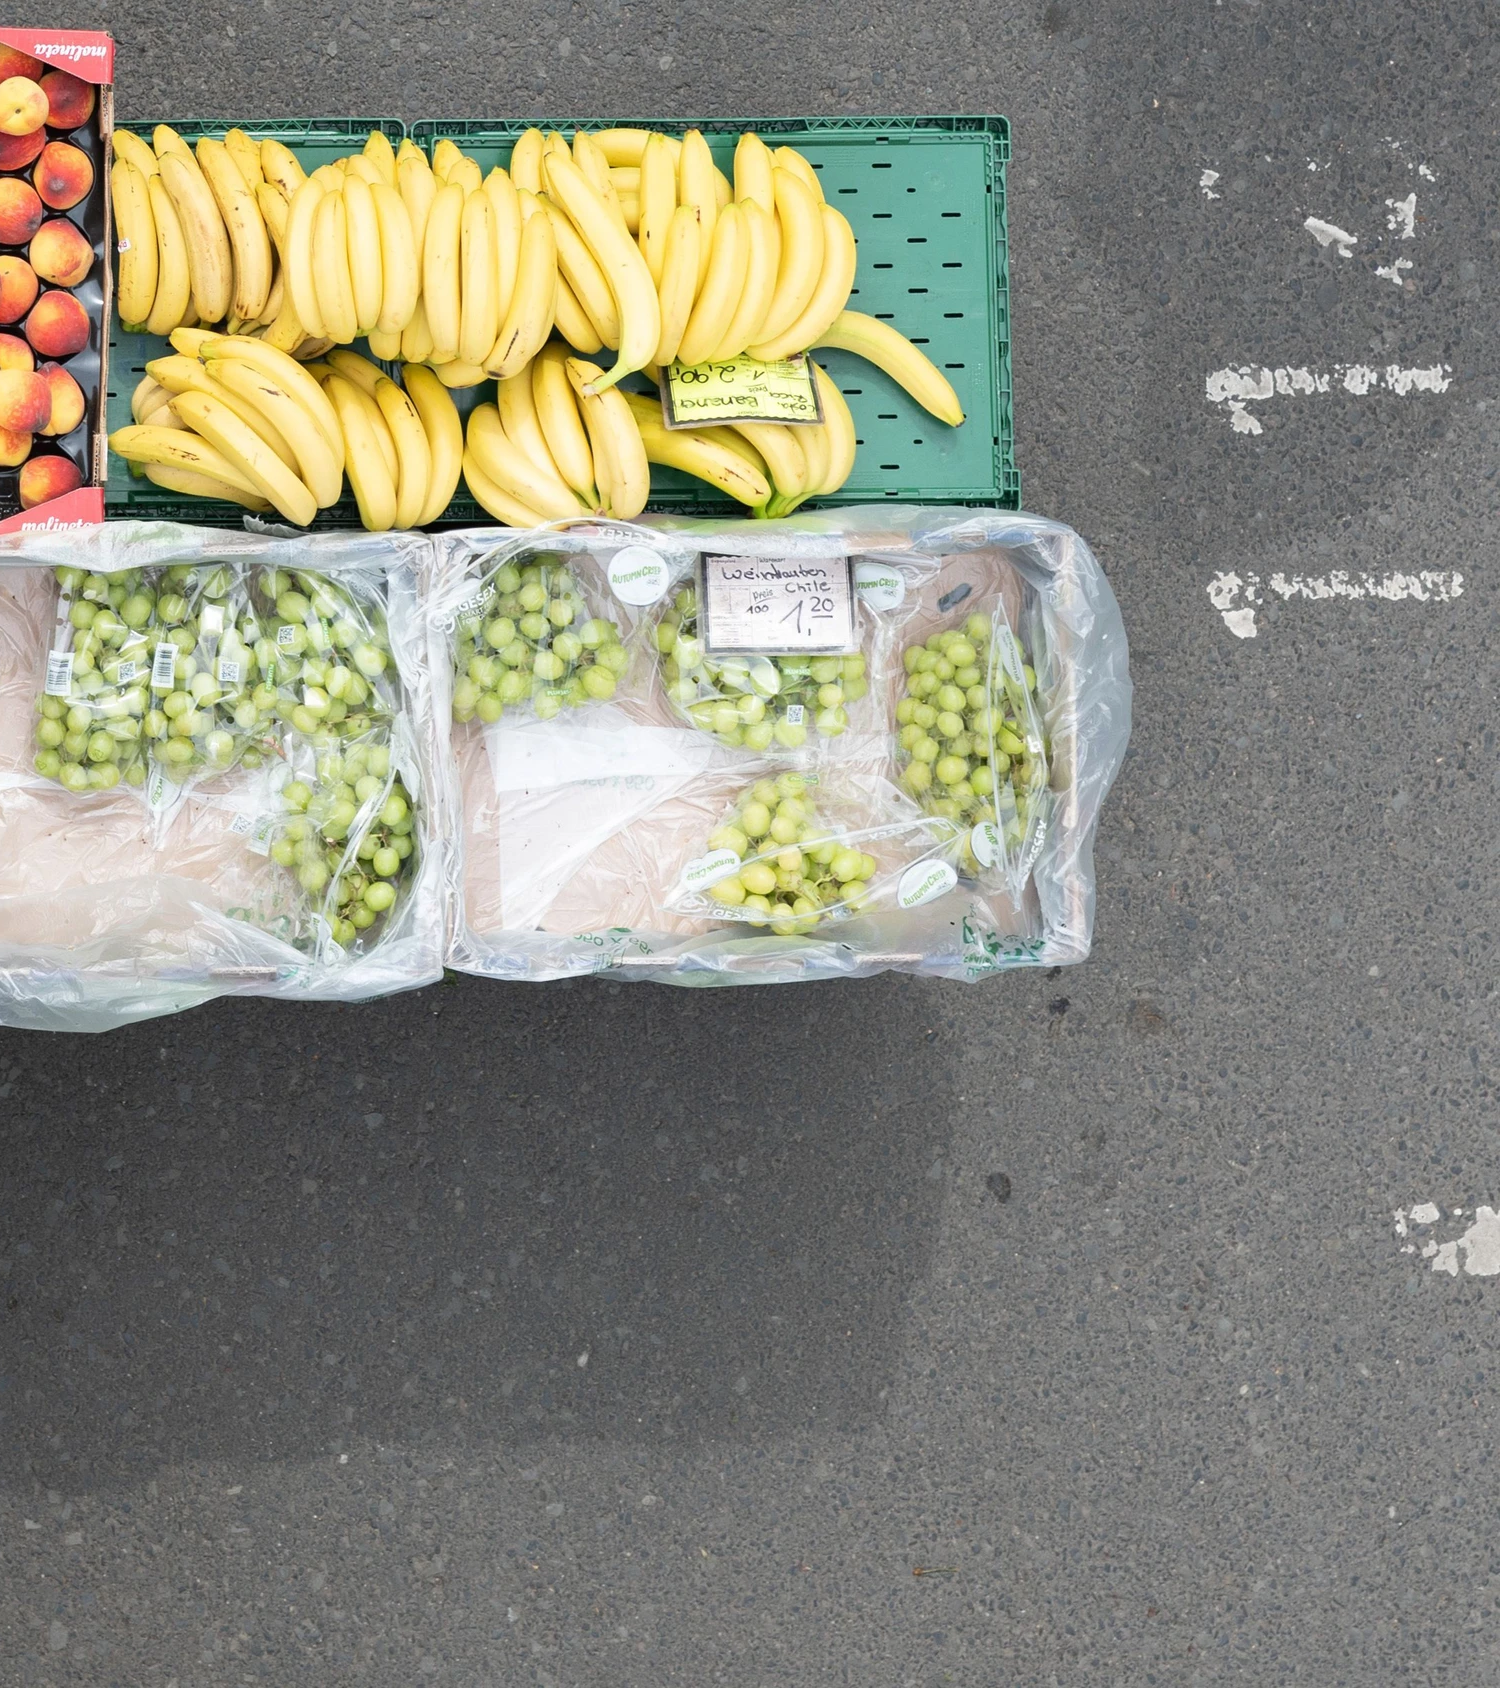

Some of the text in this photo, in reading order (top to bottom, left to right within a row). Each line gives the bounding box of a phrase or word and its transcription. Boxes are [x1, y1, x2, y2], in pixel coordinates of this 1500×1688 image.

[33, 42, 107, 61] molineta
[785, 580, 832, 594] Chile
[752, 588, 774, 602] Preis
[746, 603, 769, 615] 100
